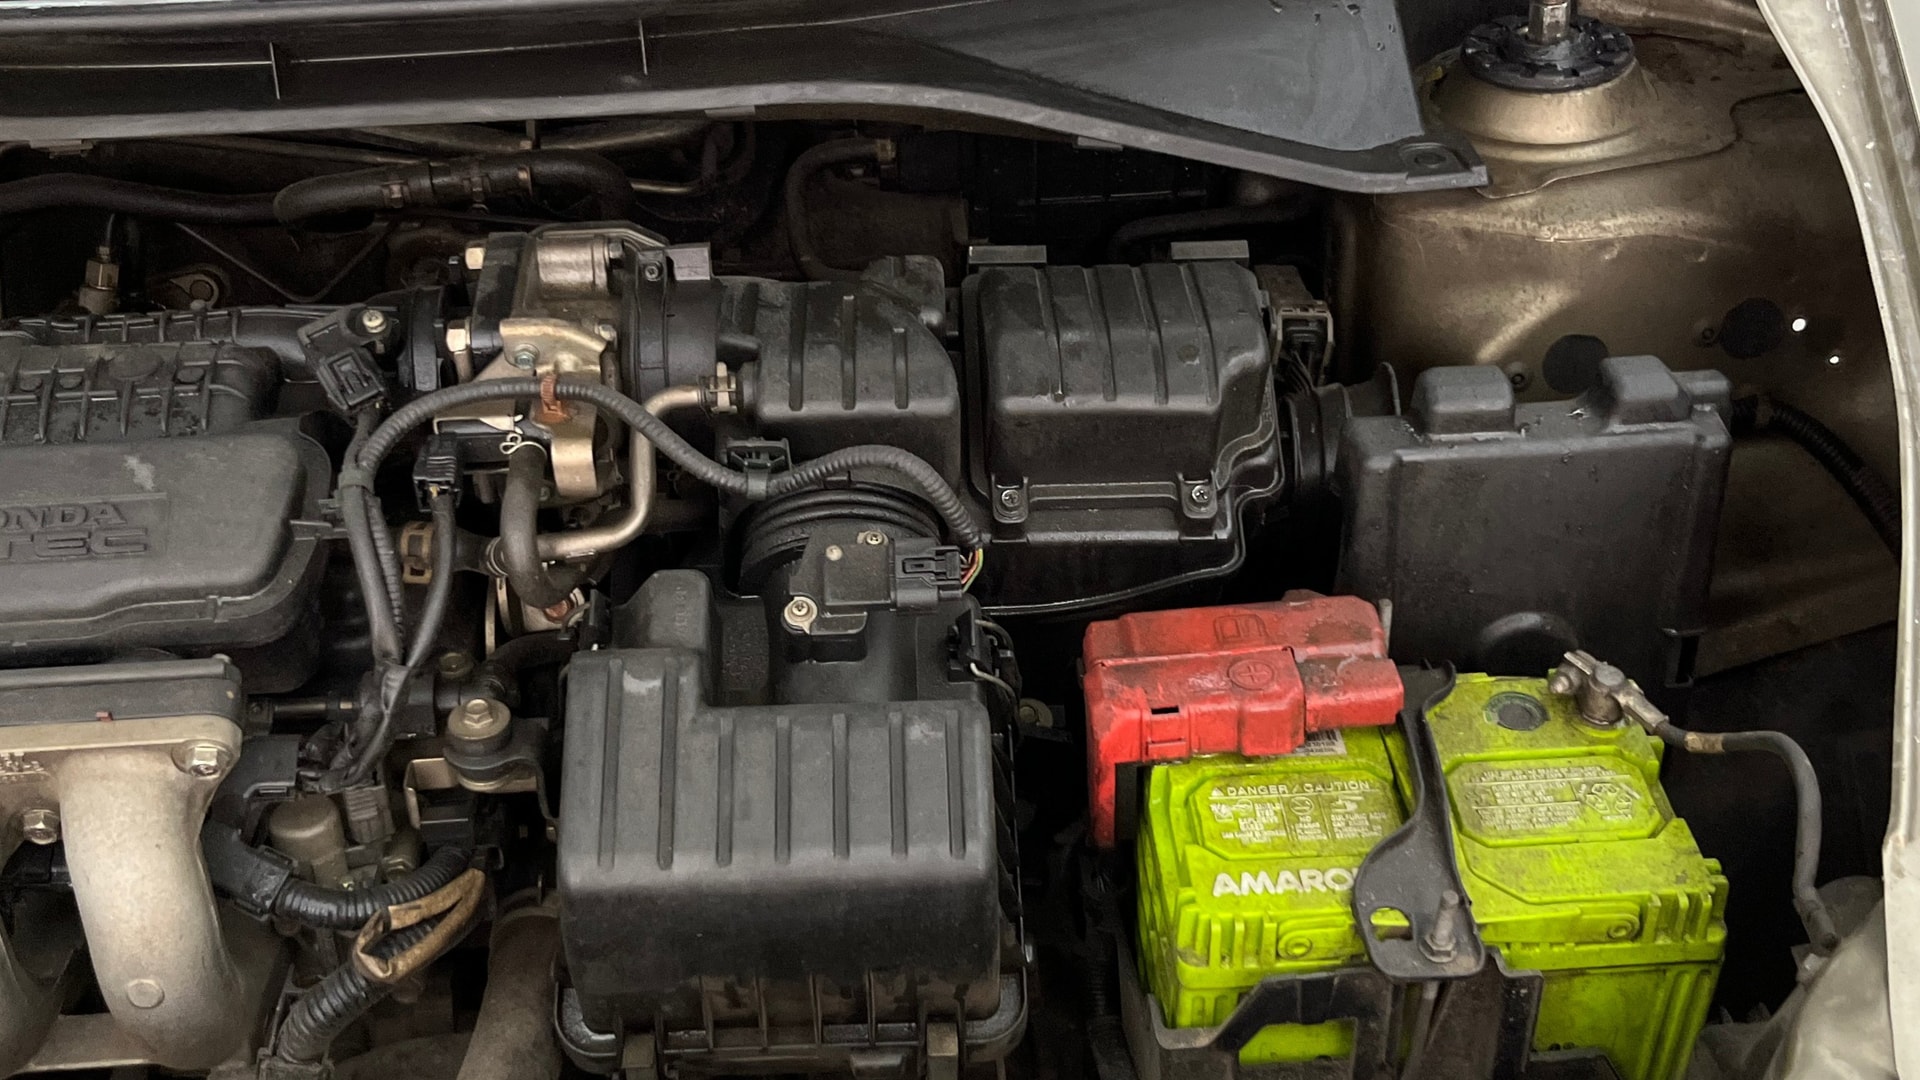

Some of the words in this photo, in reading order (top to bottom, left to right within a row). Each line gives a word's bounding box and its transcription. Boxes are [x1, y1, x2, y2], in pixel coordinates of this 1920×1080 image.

[1227, 785, 1288, 797] DANGER
[1303, 781, 1370, 793] CAUTION
[1213, 867, 1358, 897] AMARO
